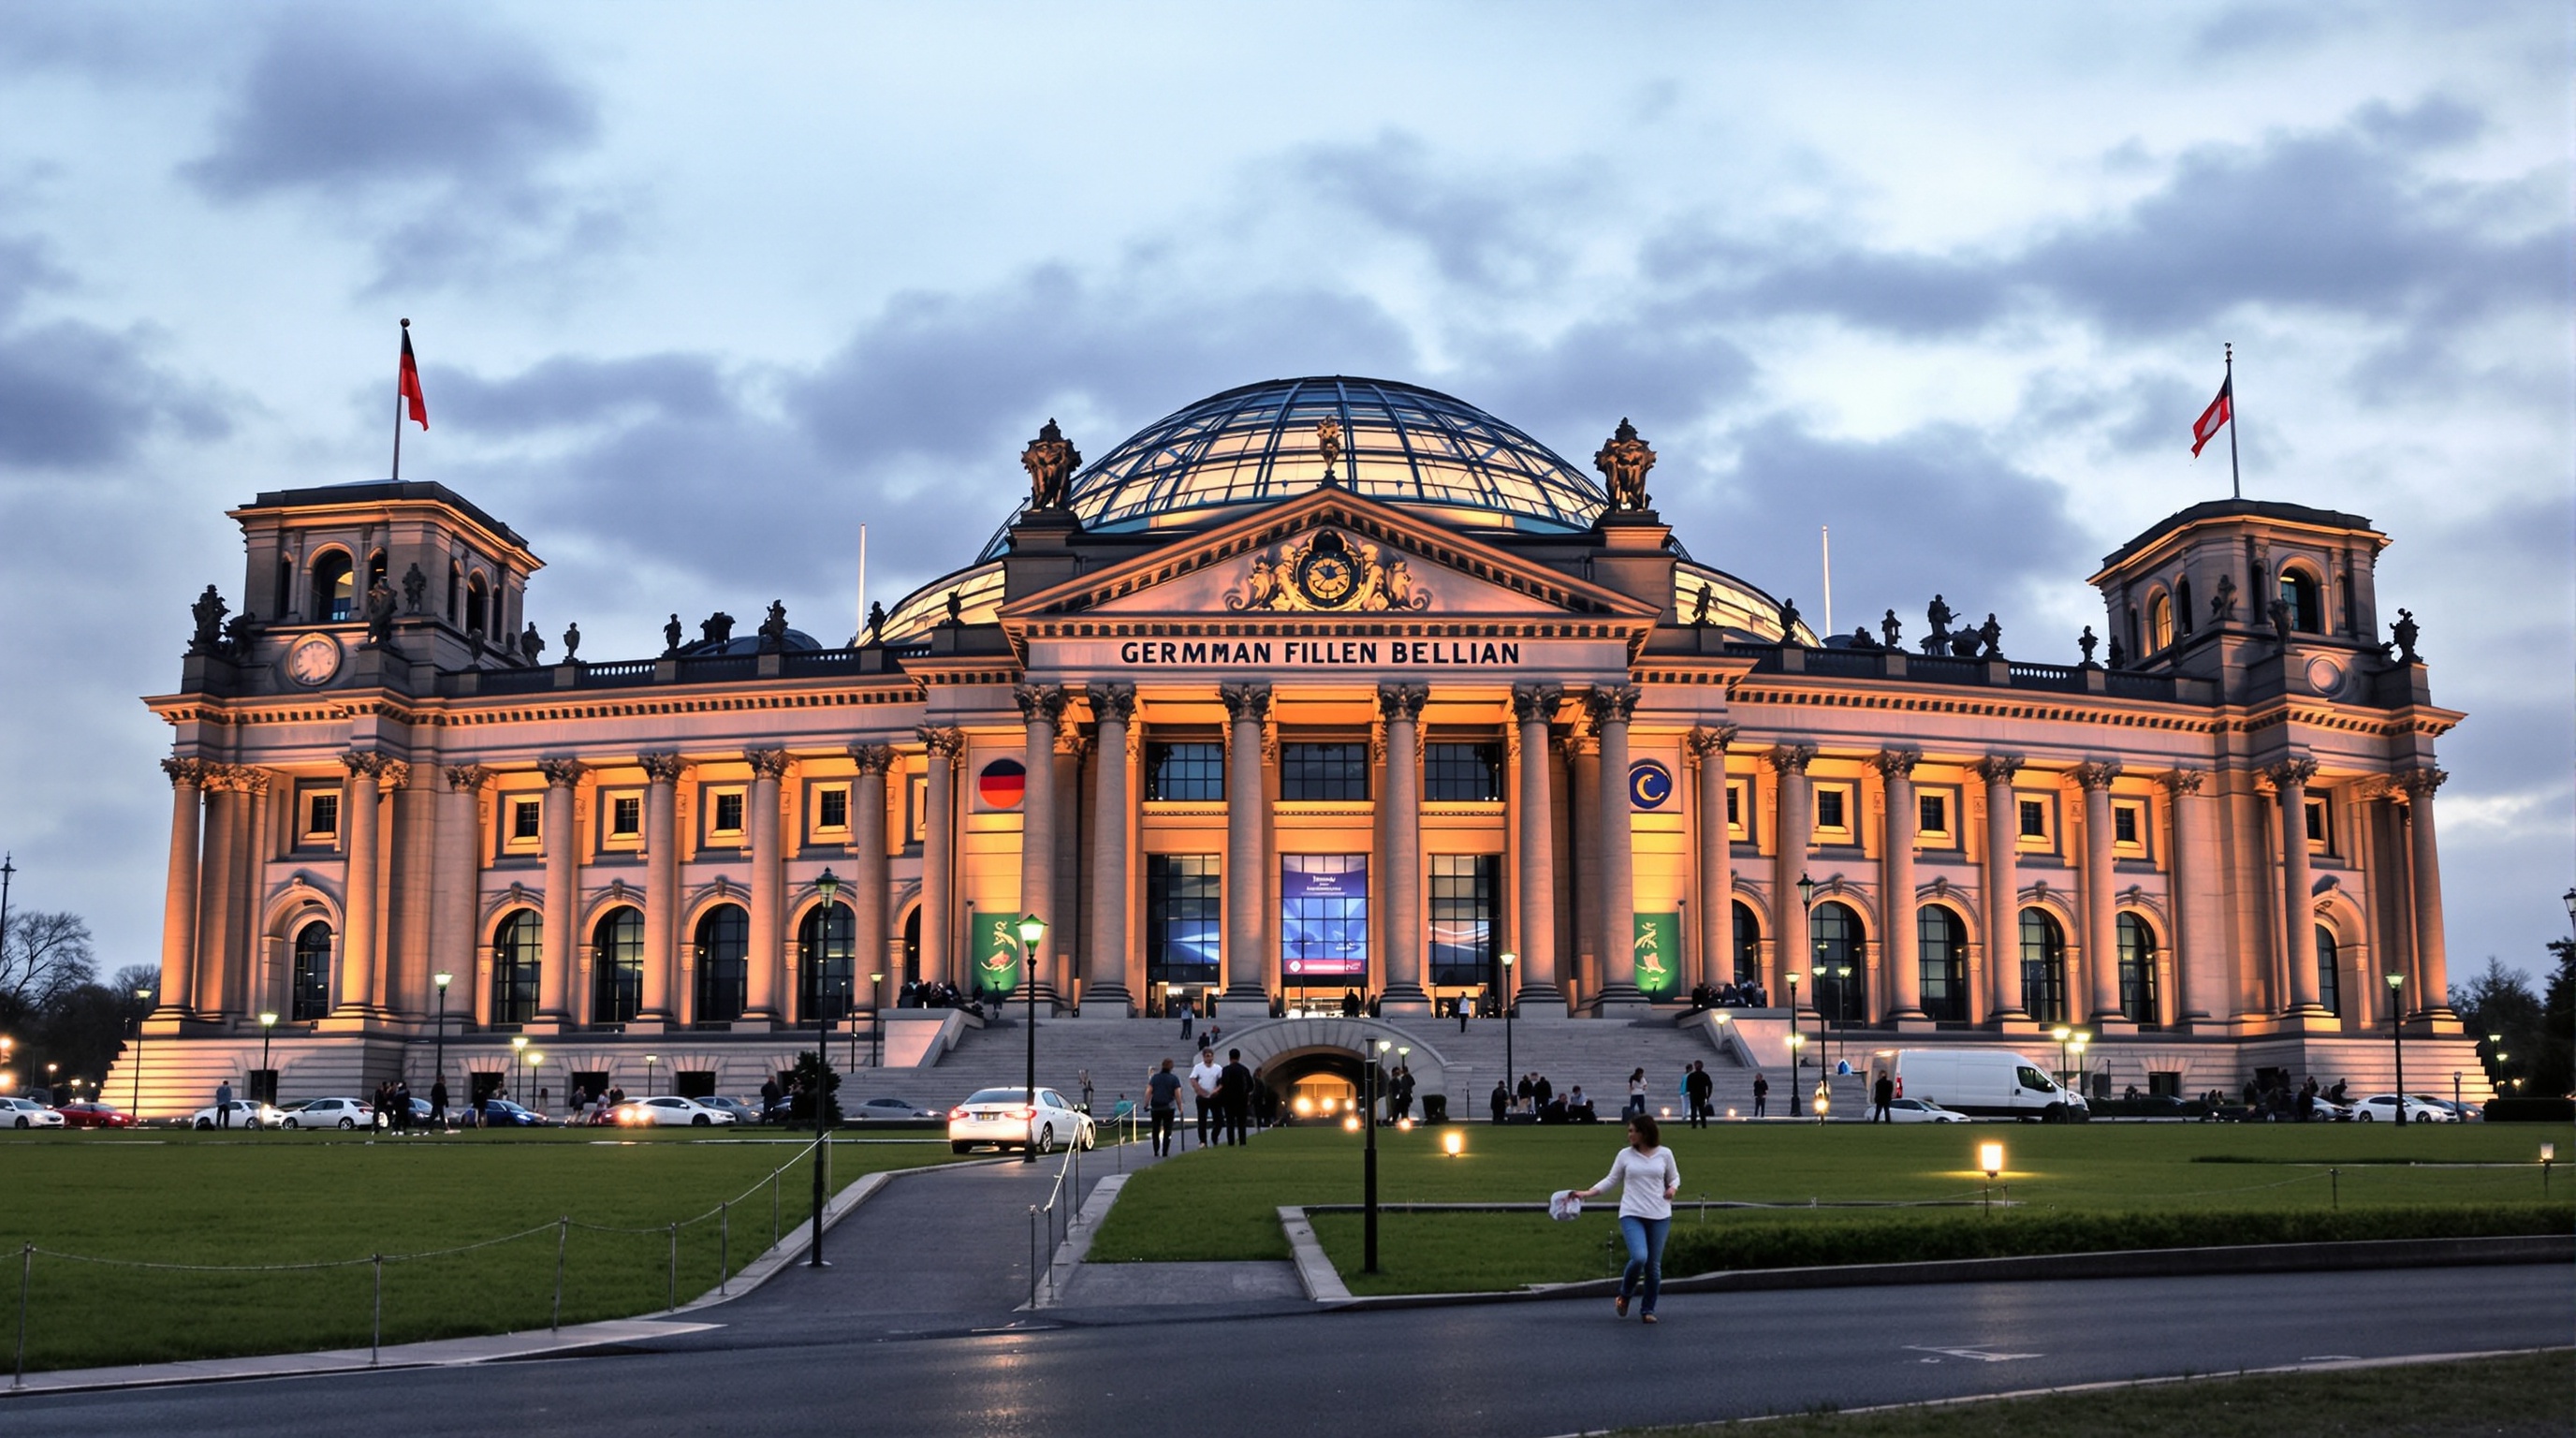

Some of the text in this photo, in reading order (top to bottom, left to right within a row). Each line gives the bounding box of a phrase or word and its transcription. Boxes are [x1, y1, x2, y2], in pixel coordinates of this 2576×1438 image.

[1122, 641, 1519, 664] GERMMAN FILLEN BELLIAN
